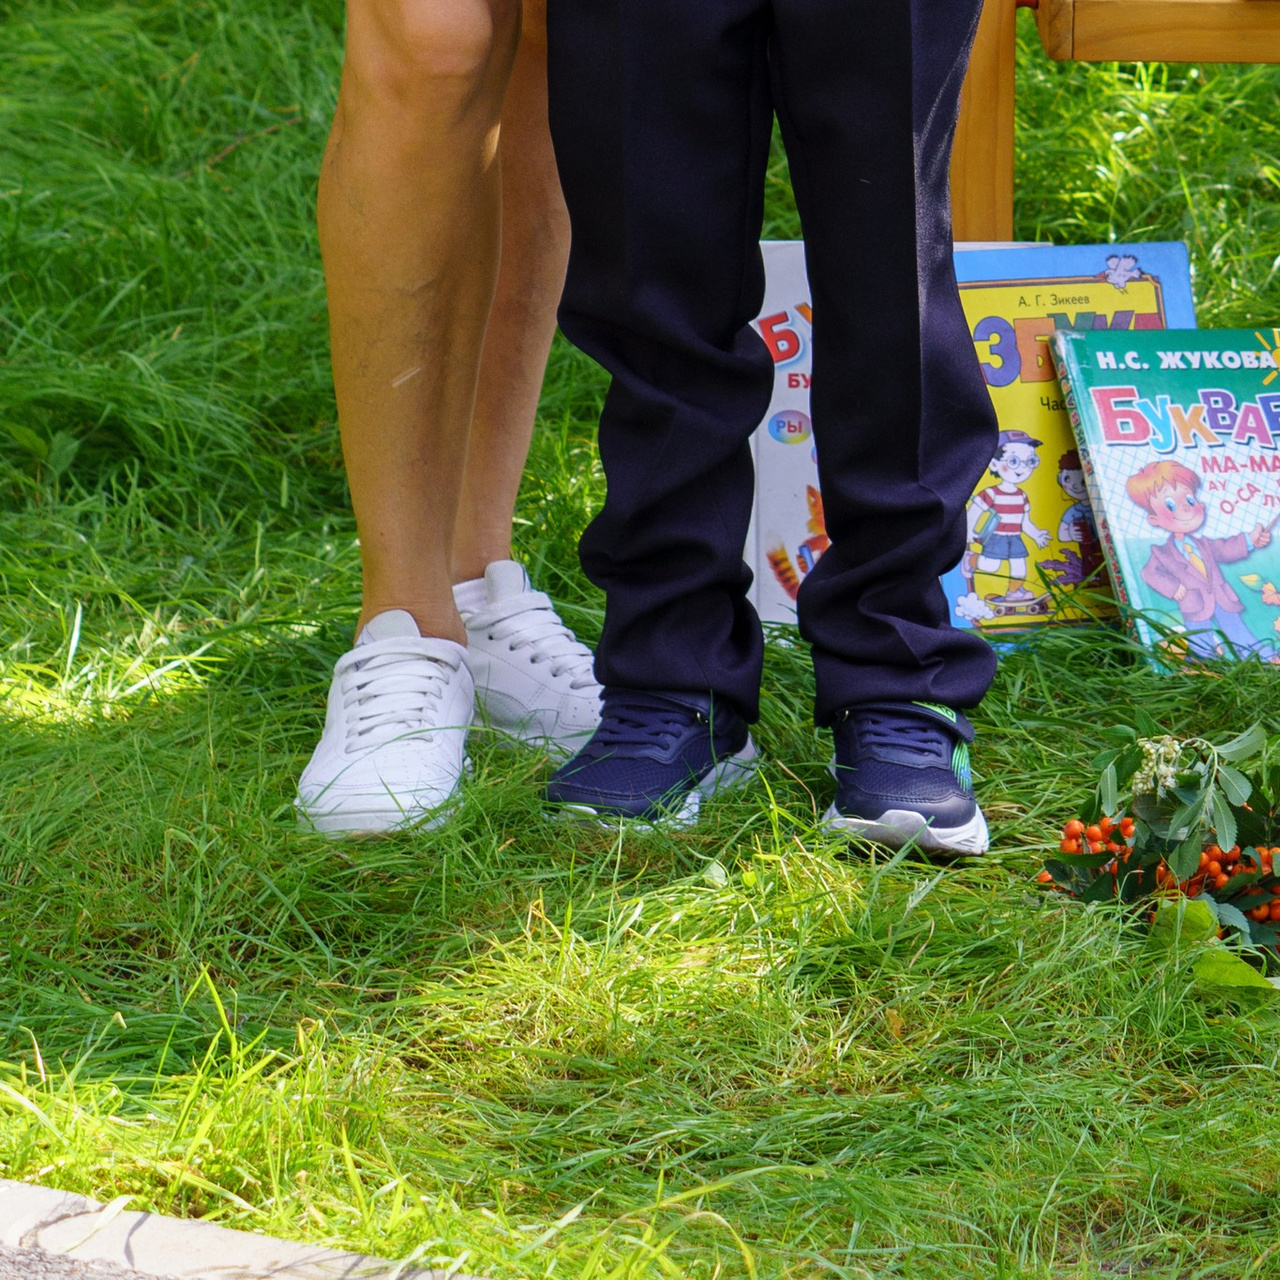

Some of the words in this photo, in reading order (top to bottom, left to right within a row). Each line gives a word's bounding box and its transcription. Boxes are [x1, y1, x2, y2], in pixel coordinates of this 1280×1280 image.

[1018, 295, 1031, 307] А.
[1035, 294, 1046, 307] Г.
[1050, 293, 1090, 307] Зикеев
[1095, 351, 1150, 370] Н.С.
[1156, 350, 1279, 370] ЖУКОВА
[775, 419, 803, 434] РЫ
[1208, 479, 1228, 492] АУ
[1219, 481, 1262, 515] О-СА
